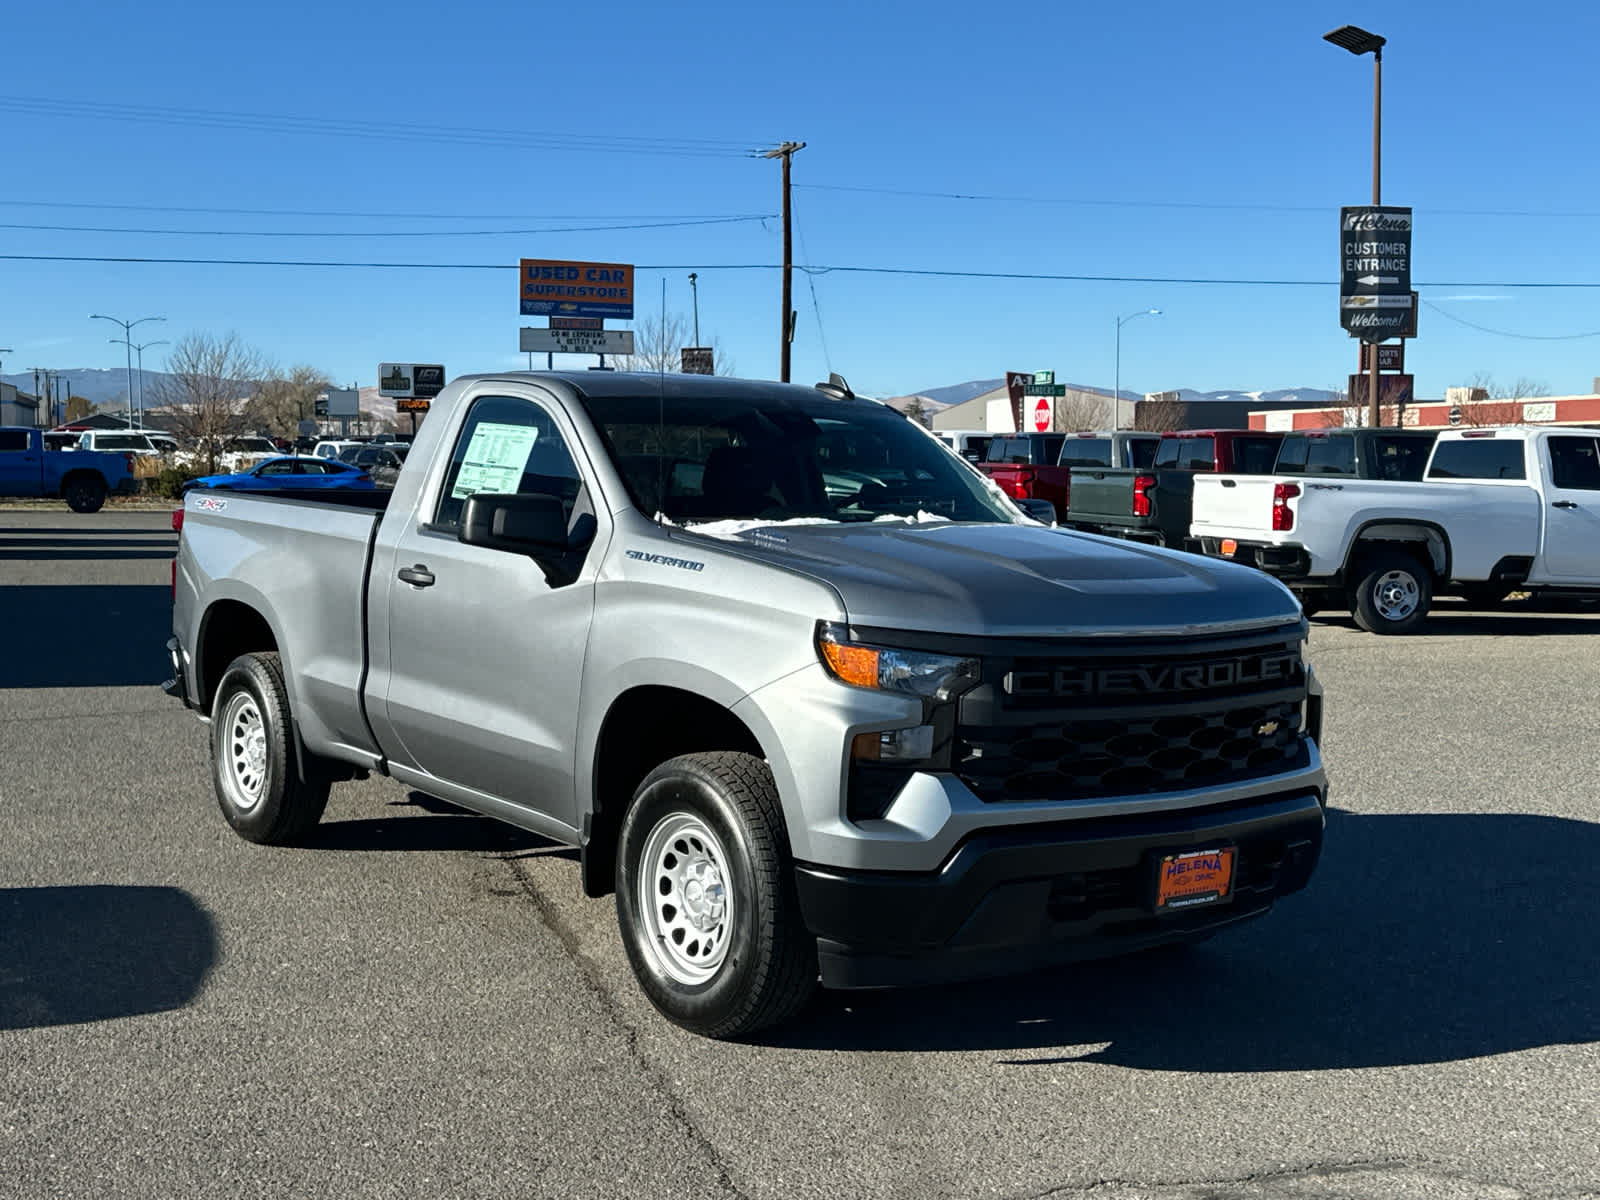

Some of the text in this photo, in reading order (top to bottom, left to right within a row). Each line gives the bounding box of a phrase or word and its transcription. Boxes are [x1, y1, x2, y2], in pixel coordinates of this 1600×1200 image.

[1350, 213, 1409, 231] Helena
[1345, 242, 1406, 255] CUSTOMER
[1346, 259, 1406, 271] ENTRANCE
[528, 267, 625, 284] USED CAR
[525, 284, 628, 298] SUPERSTORE
[1350, 313, 1404, 328] Welcome!
[1035, 409, 1050, 423] STOP
[625, 549, 705, 572] SILVERADO
[1003, 653, 1302, 695] CHEVROLET
[1166, 859, 1223, 880] HELENA
